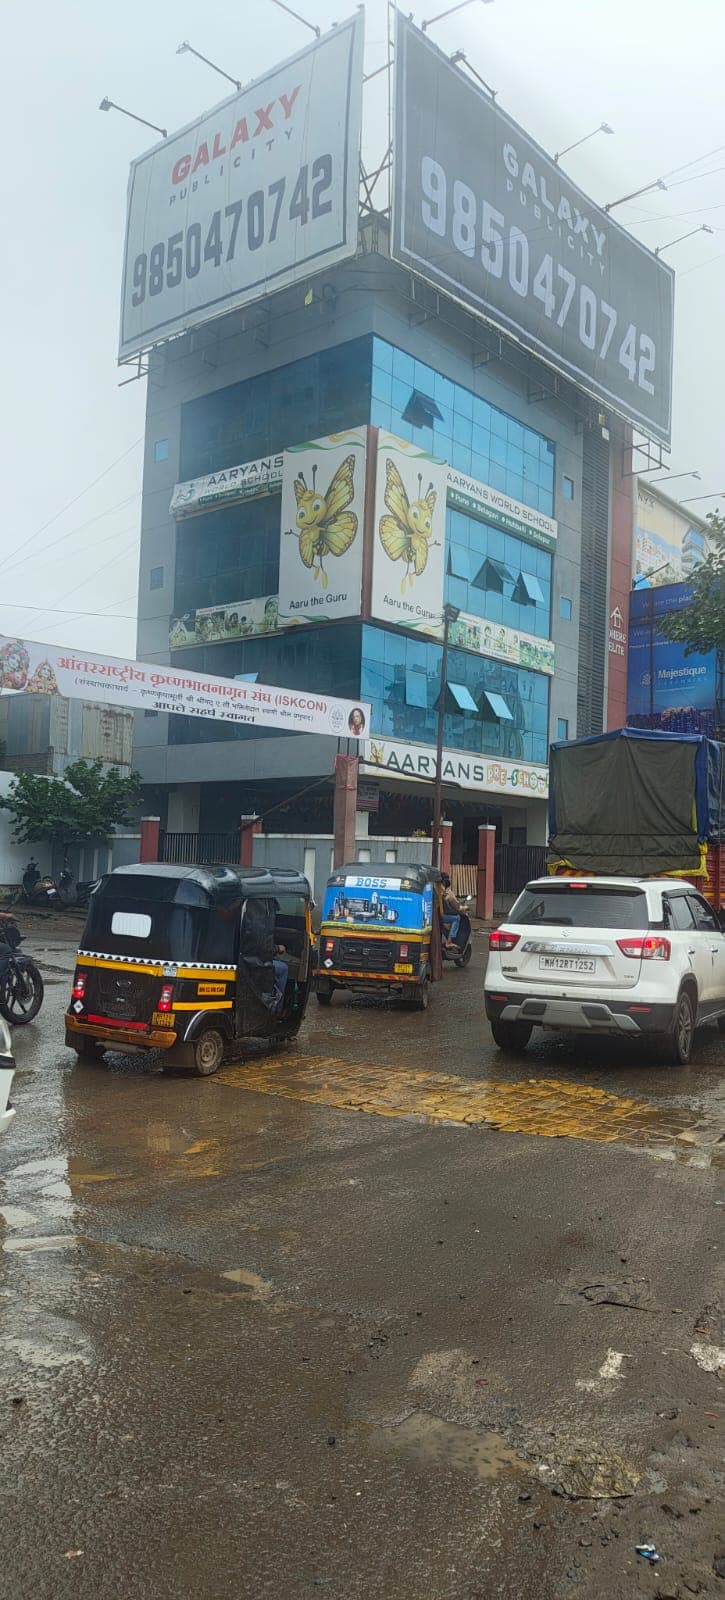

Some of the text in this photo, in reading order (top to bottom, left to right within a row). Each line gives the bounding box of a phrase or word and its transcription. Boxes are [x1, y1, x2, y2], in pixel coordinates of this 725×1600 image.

[171, 84, 302, 185] GALAXY
[169, 128, 293, 206] PUBLICITY
[503, 143, 606, 257] GALAXY
[132, 154, 333, 307] 9850470742
[507, 179, 605, 276] PUBLICITY
[421, 156, 656, 396] 9850470742
[207, 456, 284, 487] AARYANS
[242, 471, 284, 487] SCHOOL
[447, 473, 554, 533] AARYANS WORLD SCHOOL
[289, 592, 347, 610] Aaru the Guru
[383, 594, 401, 611] Aaru
[402, 600, 414, 611] the
[57, 655, 328, 714] आंतरराष्ट्रीय कृष्णभावनामृत संघ (ISKCON)
[657, 665, 707, 680] Majestique
[152, 701, 255, 723] आपले सहर्ष स्वागत
[355, 877, 388, 888] BOSS
[544, 958, 594, 971] MH12RT1252
